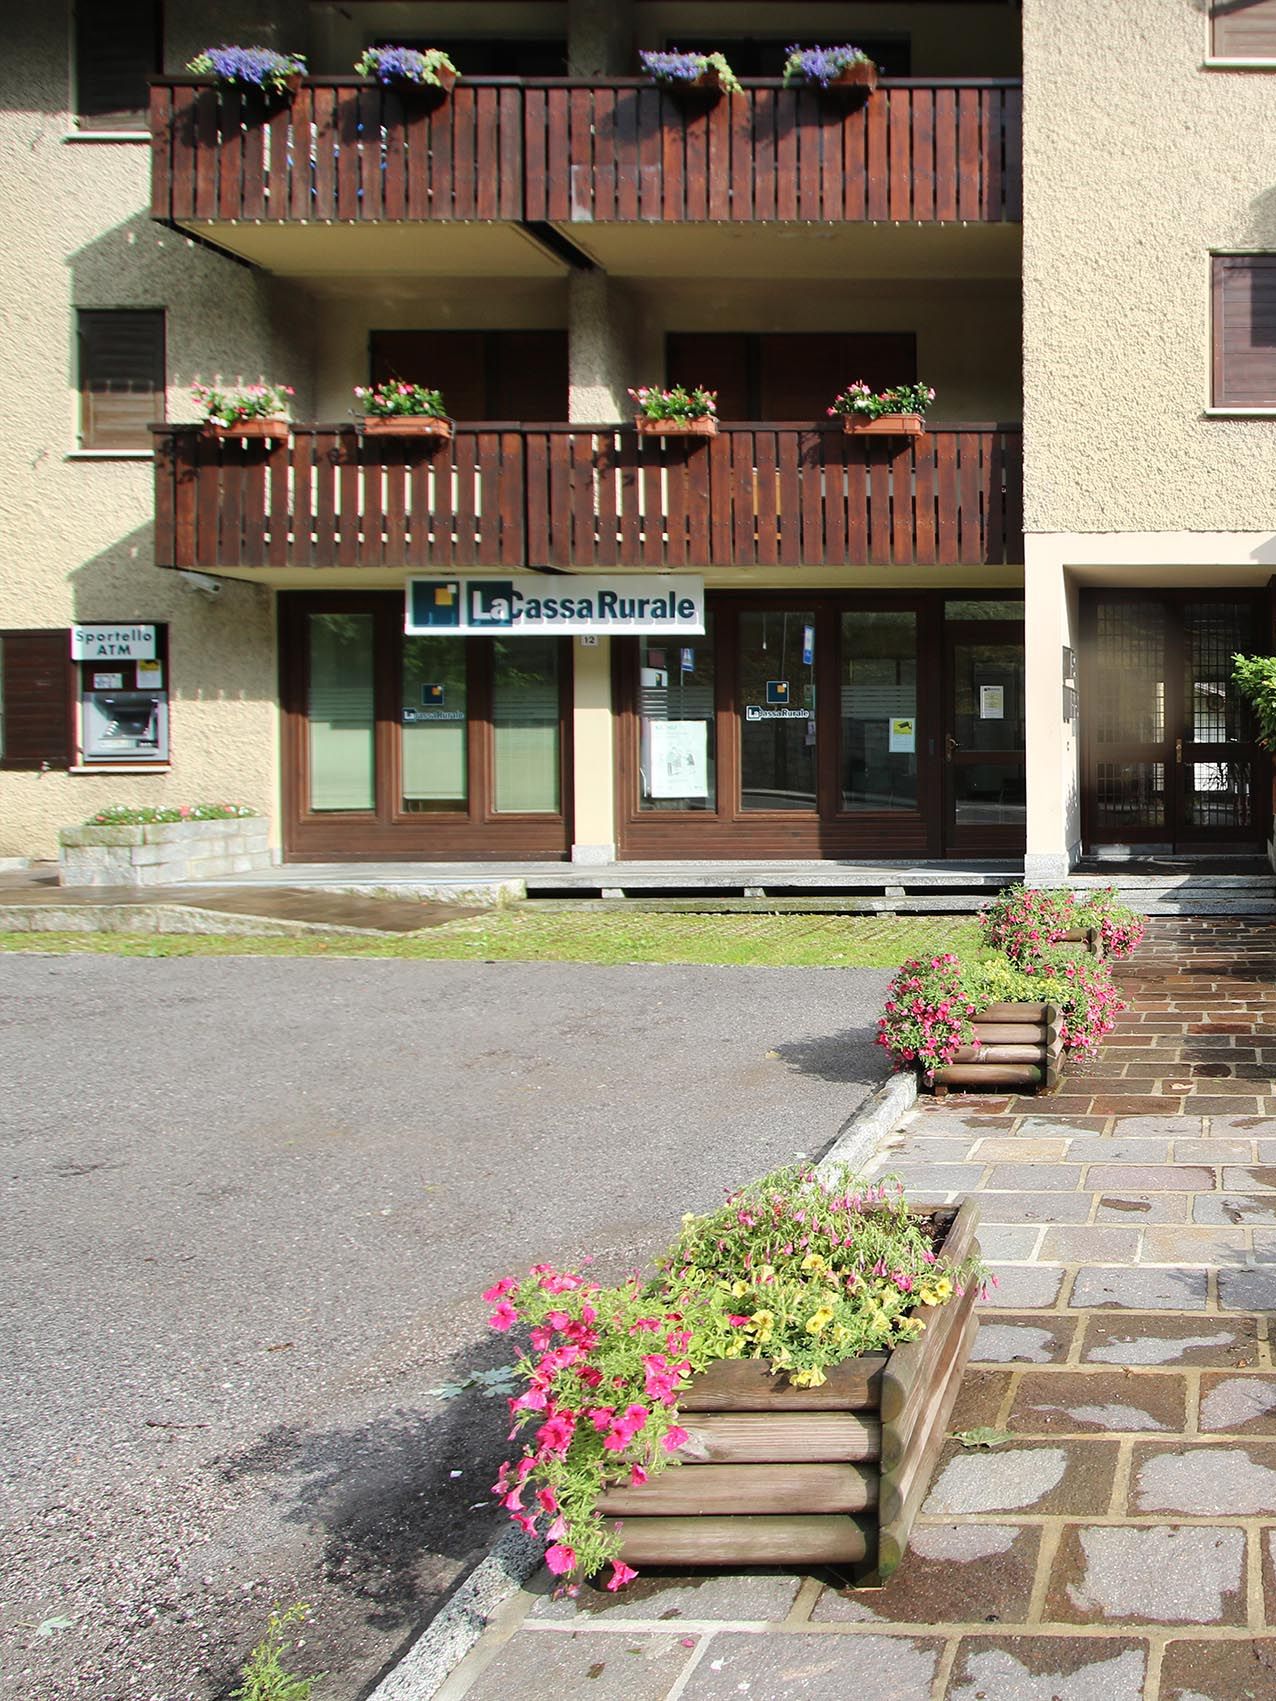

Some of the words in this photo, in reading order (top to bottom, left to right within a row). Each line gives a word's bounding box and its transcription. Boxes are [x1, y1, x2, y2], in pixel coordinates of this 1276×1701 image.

[76, 629, 152, 645] Sportello
[584, 636, 595, 644] 12
[97, 645, 131, 655] ATM
